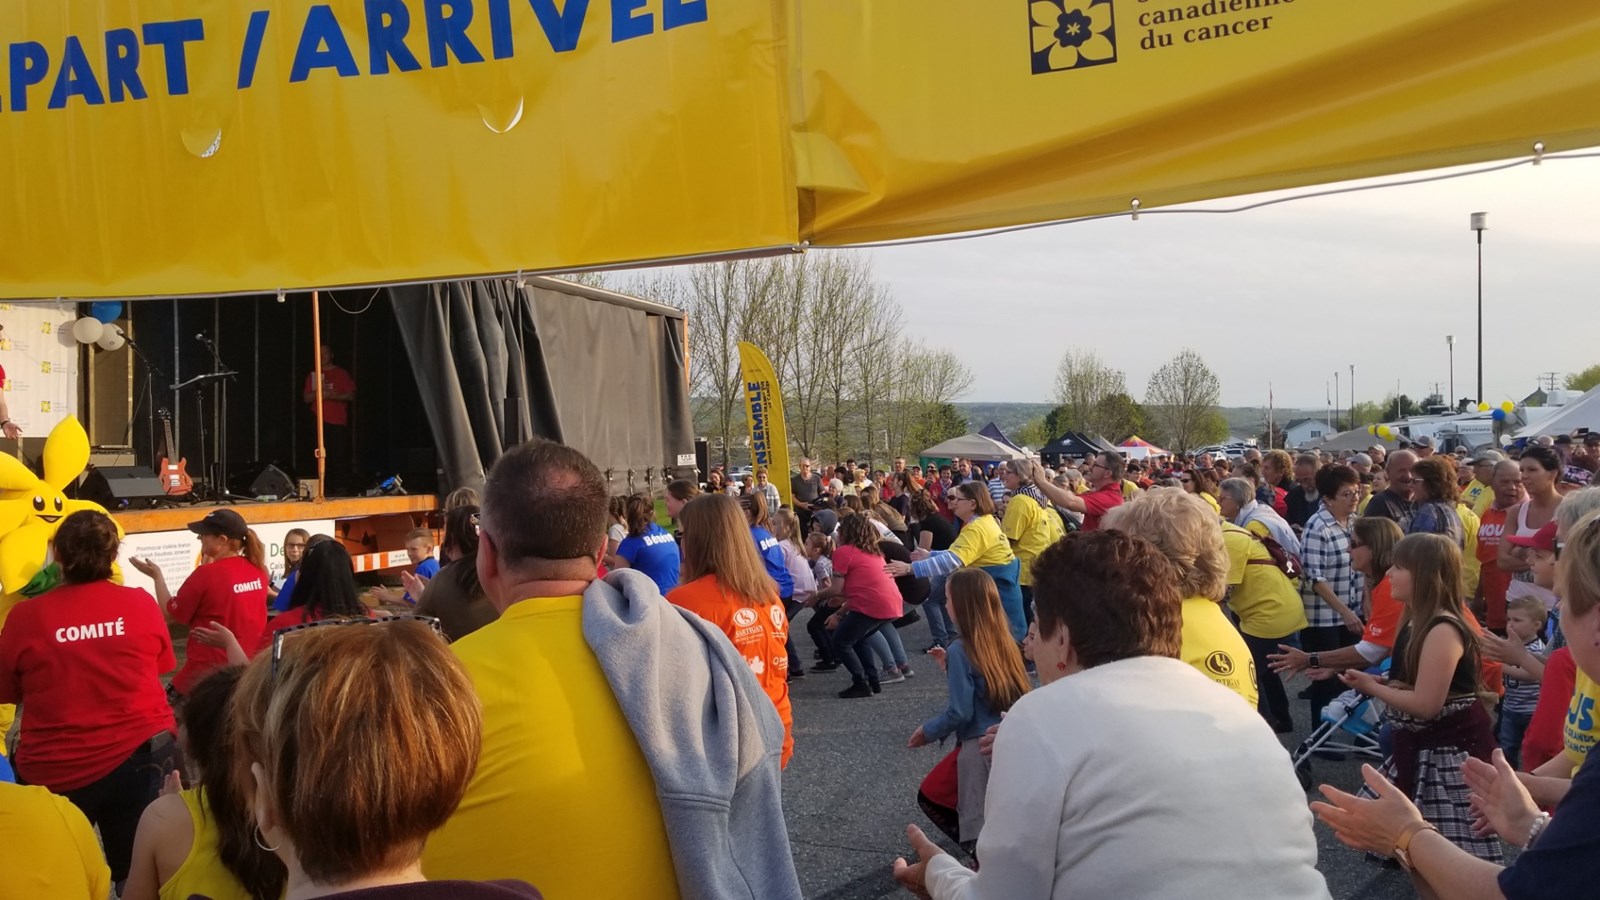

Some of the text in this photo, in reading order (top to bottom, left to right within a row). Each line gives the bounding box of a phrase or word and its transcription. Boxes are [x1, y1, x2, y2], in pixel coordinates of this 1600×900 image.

[1138, 0, 1295, 27] canadien
[1140, 16, 1273, 50] du cancer
[0, 19, 204, 112] PART
[1479, 523, 1505, 537] NOU
[270, 562, 284, 571] Cais
[233, 577, 262, 594] COMITÉ
[55, 617, 125, 643] COMITÉ
